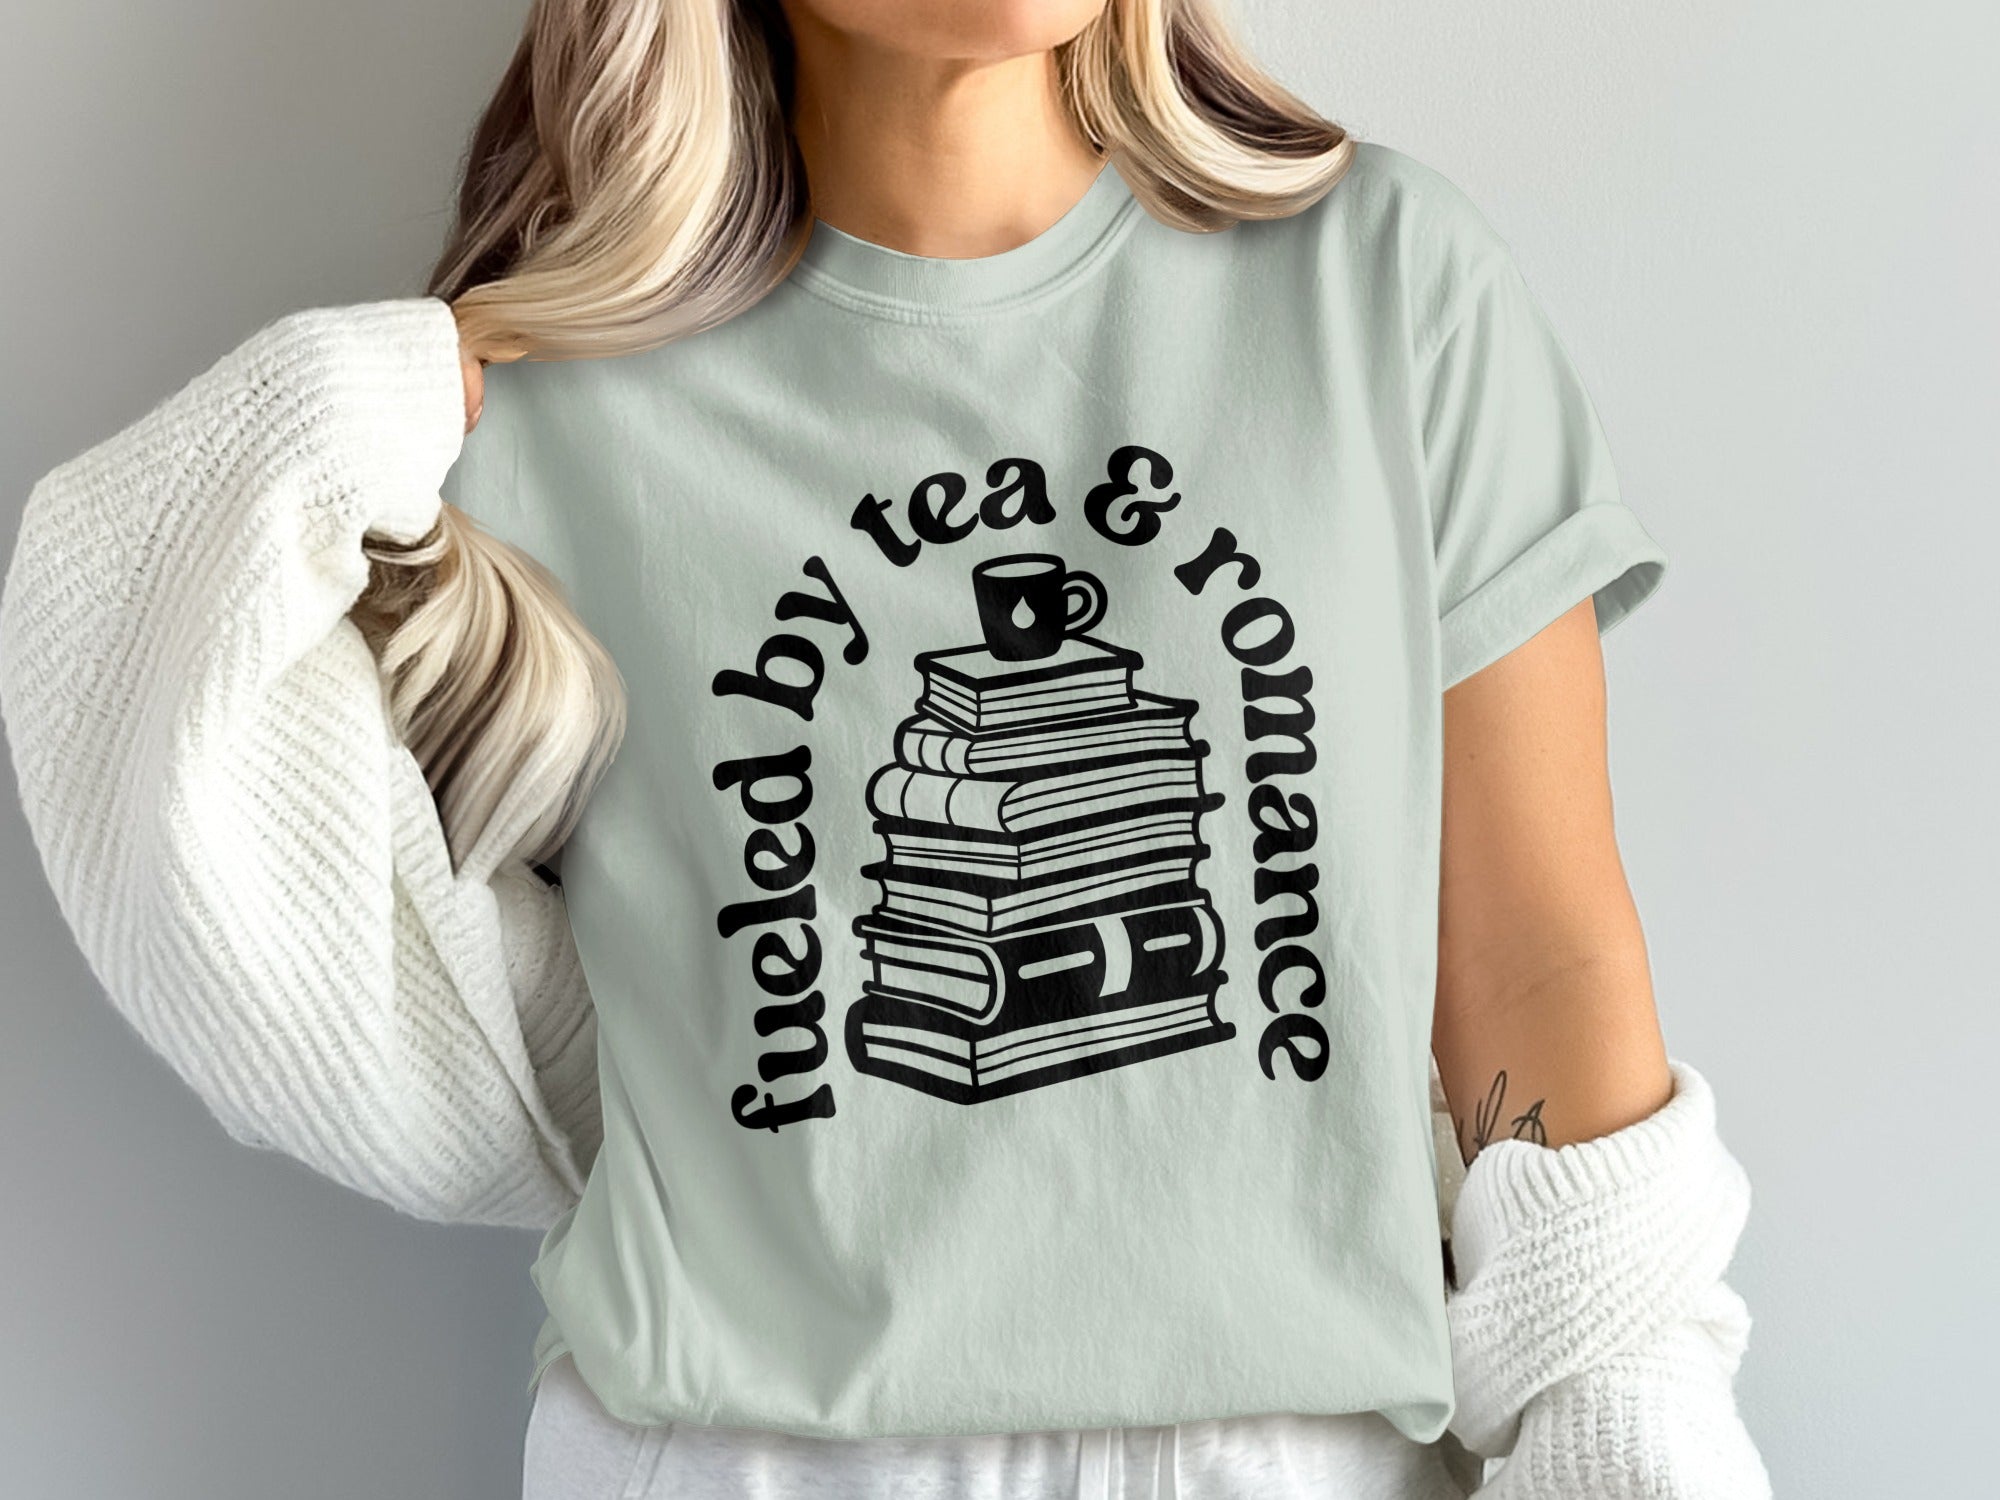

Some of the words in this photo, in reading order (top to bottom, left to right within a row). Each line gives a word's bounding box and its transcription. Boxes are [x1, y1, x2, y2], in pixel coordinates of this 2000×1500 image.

[850, 457, 1057, 568] tea
[1083, 445, 1182, 547] &
[711, 555, 870, 722] by
[1173, 527, 1330, 1083] romance
[711, 744, 837, 1134] fueled
